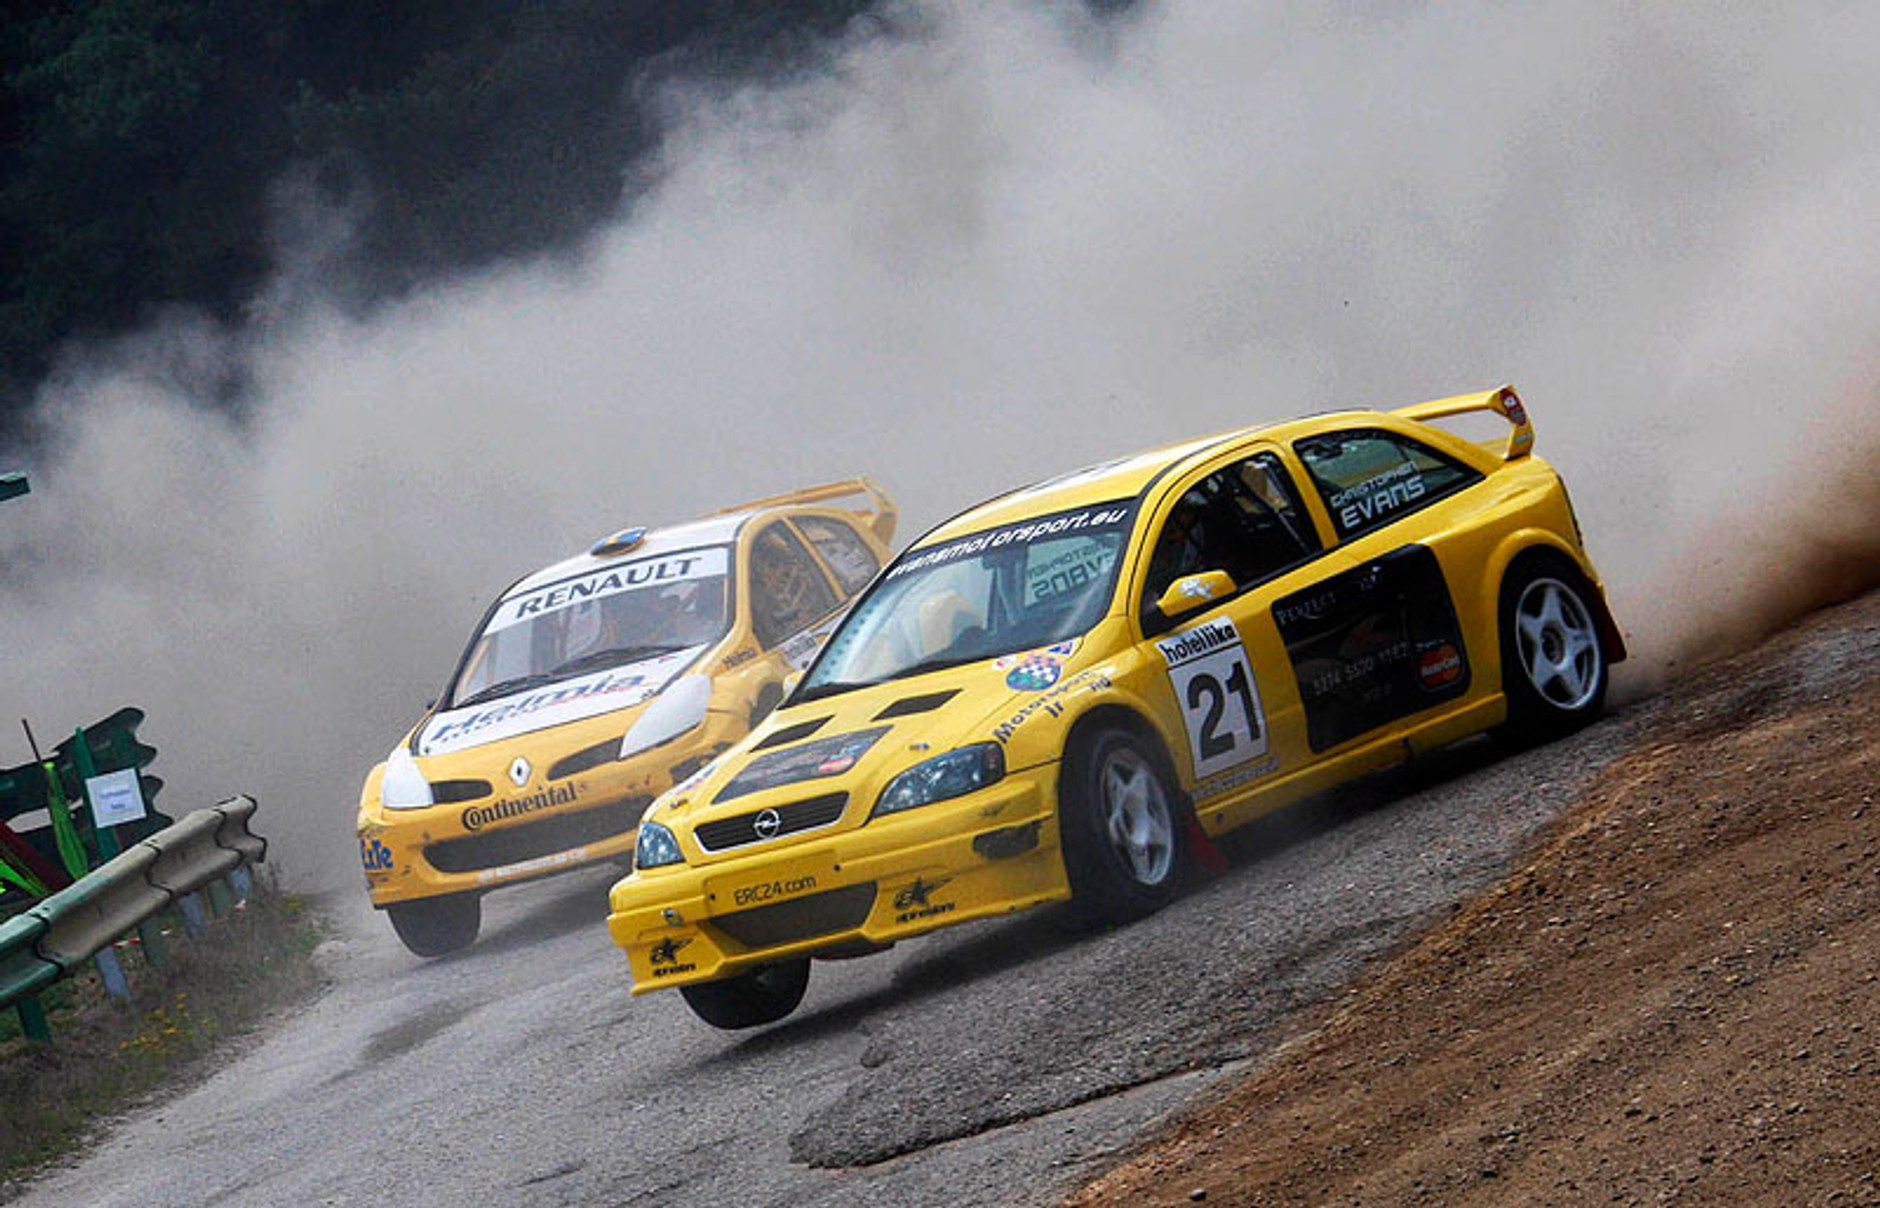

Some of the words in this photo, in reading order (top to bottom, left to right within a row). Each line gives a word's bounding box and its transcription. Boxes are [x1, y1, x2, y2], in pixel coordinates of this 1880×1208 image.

[1341, 475, 1426, 528] EVANS
[515, 557, 703, 620] RENAULT
[1159, 624, 1237, 664] hotellika
[431, 673, 647, 742] Helmia
[1187, 660, 1261, 761] 21
[461, 781, 579, 832] Continental
[733, 875, 816, 906] ERC24.com
